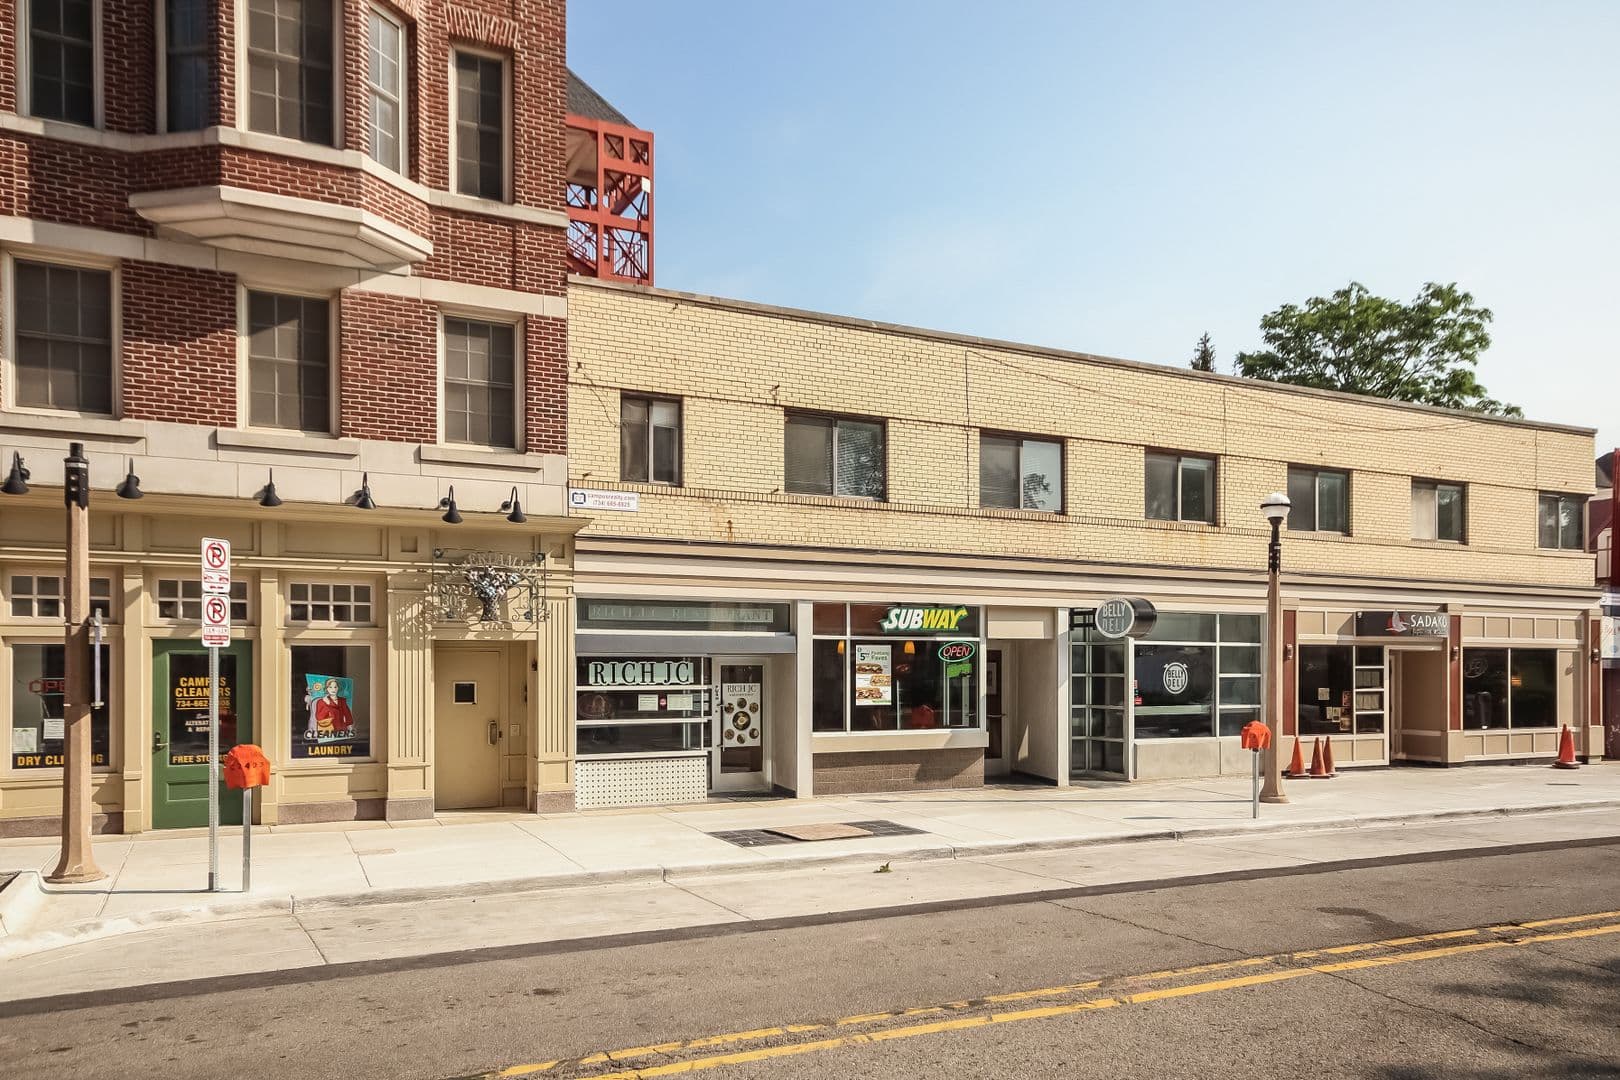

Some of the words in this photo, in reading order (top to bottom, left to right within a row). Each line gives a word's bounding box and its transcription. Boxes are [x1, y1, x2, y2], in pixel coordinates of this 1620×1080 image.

[1102, 602, 1126, 617] BELLY
[884, 606, 968, 630] SUBWAY
[1410, 614, 1448, 628] SADAKO
[1102, 618, 1125, 632] DELI
[942, 646, 971, 657] OPEN
[593, 662, 656, 684] RICH
[663, 661, 691, 685] JC
[1167, 669, 1184, 679] BELLY
[179, 677, 227, 687] CAMPS
[1167, 678, 1184, 689] DELI
[175, 687, 231, 697] CLEANRS
[727, 684, 746, 693] RICH
[747, 684, 757, 693] JC
[304, 728, 357, 740] CLEANERS
[308, 744, 353, 756] LAUNDRY
[17, 755, 41, 766] DRY
[172, 756, 194, 764] FREE
